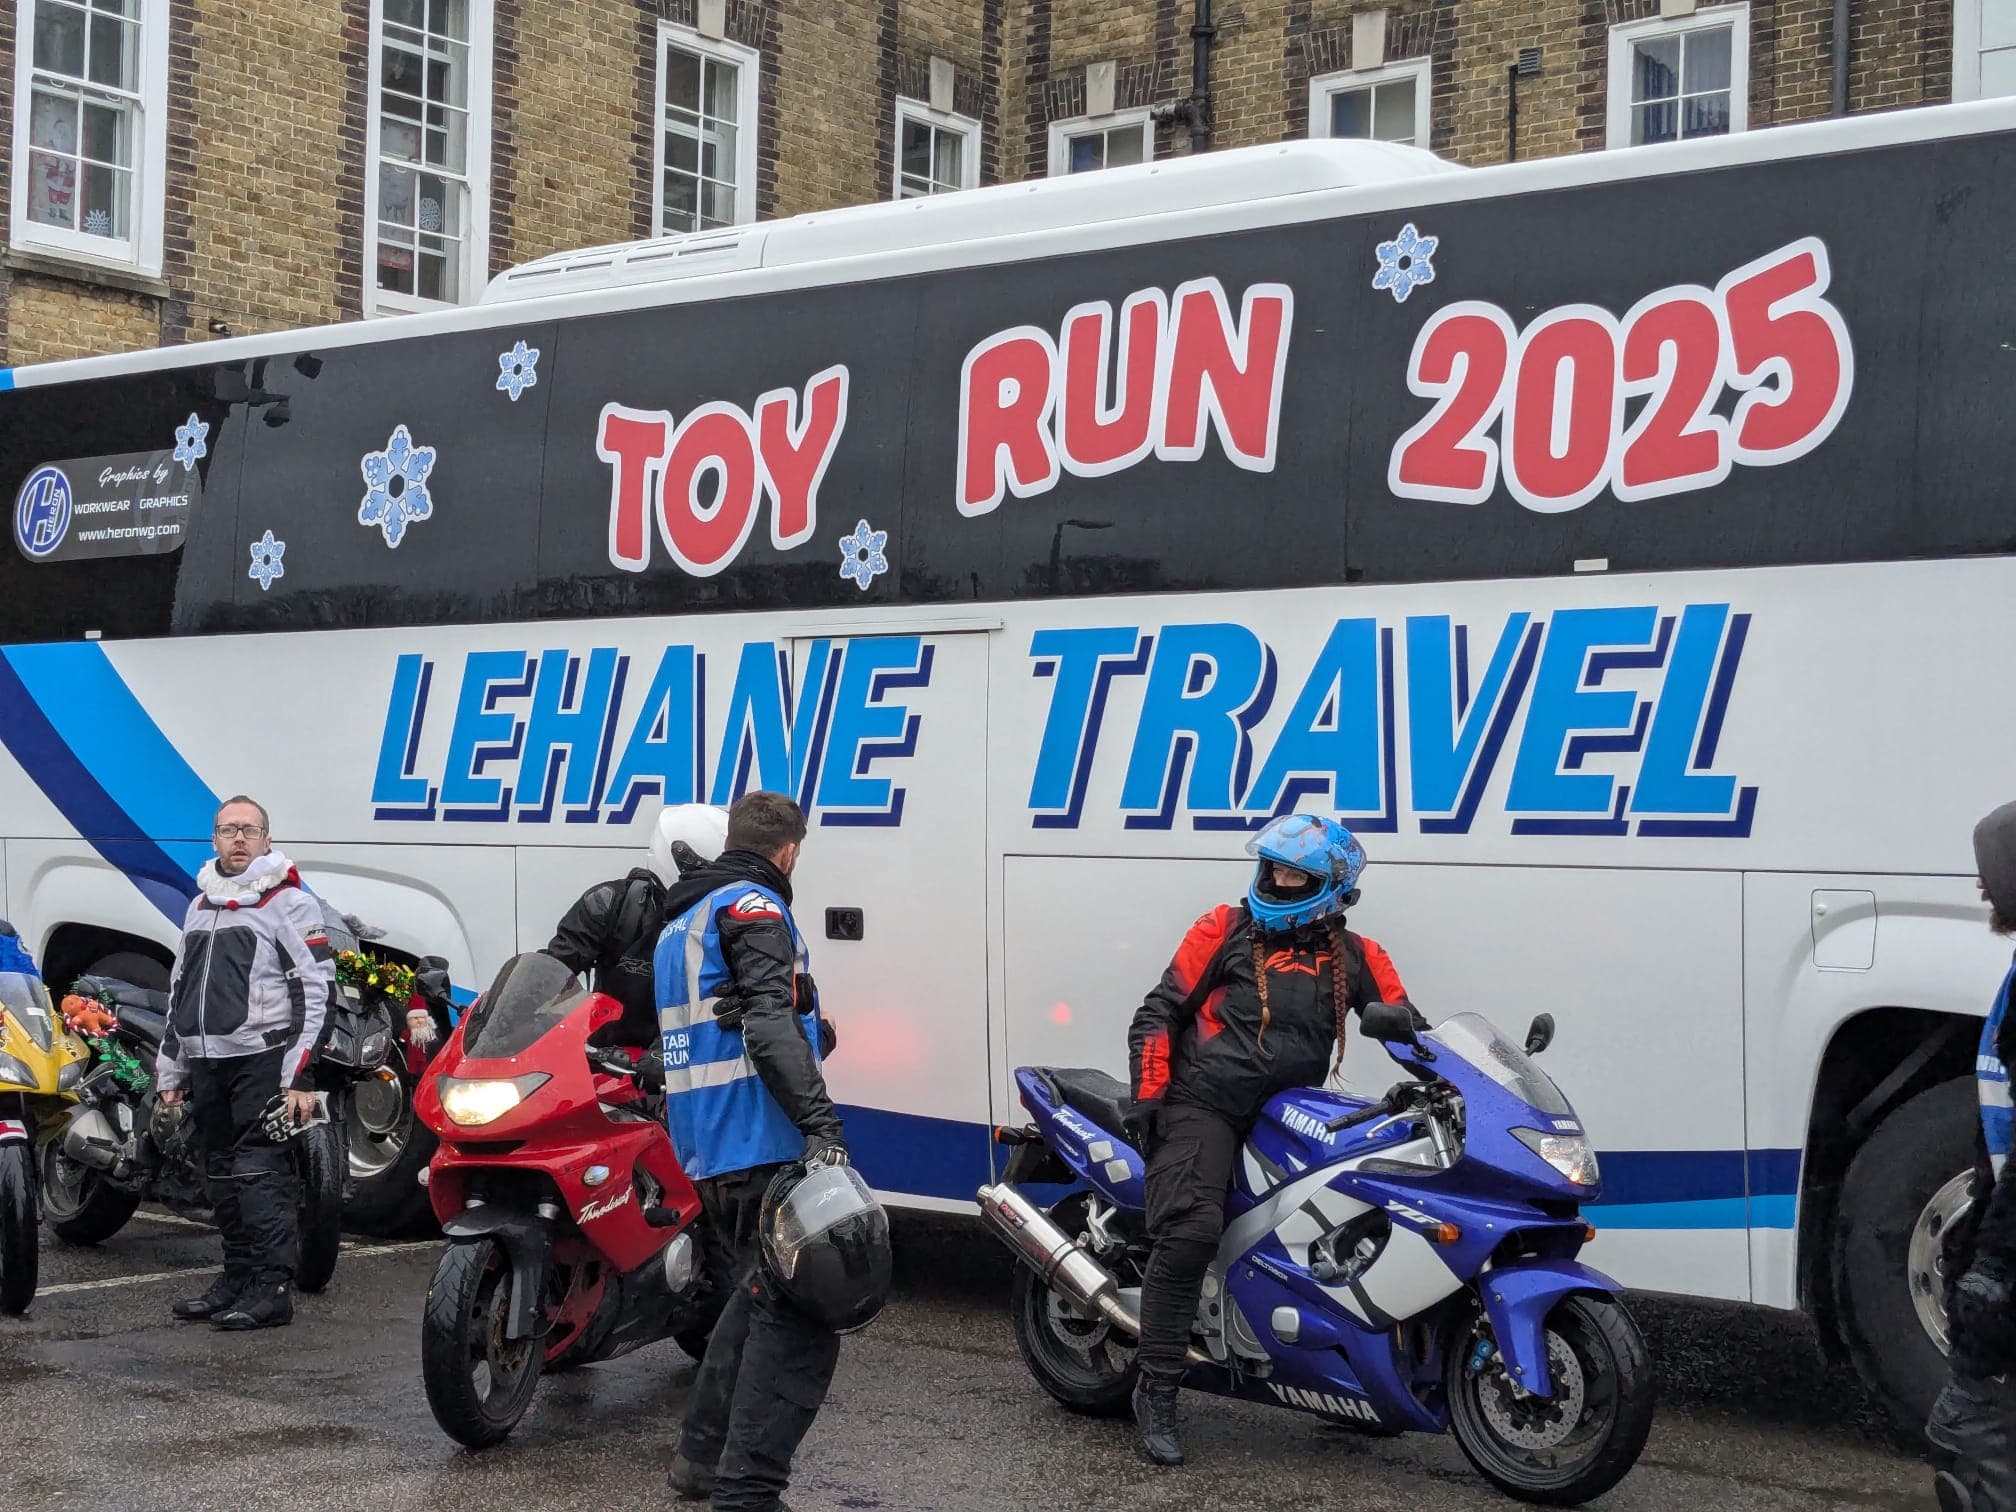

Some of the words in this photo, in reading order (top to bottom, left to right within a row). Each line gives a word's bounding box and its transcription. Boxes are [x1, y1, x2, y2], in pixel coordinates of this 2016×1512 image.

[596, 364, 849, 577] TOY
[956, 276, 1294, 518] RUN
[1388, 236, 1854, 513] 2025
[98, 466, 150, 488] Graphics
[152, 463, 169, 485] by
[46, 488, 61, 533] HERON
[73, 500, 131, 515] WORKWEAR
[139, 495, 189, 510] GRAPHICS
[78, 523, 181, 543] www.heronwg.com
[371, 635, 936, 828] LEHANE
[1028, 603, 1760, 838] TRAVEL
[1281, 1105, 1337, 1146] YAMAHA
[1266, 1381, 1382, 1423] YAMAHA
